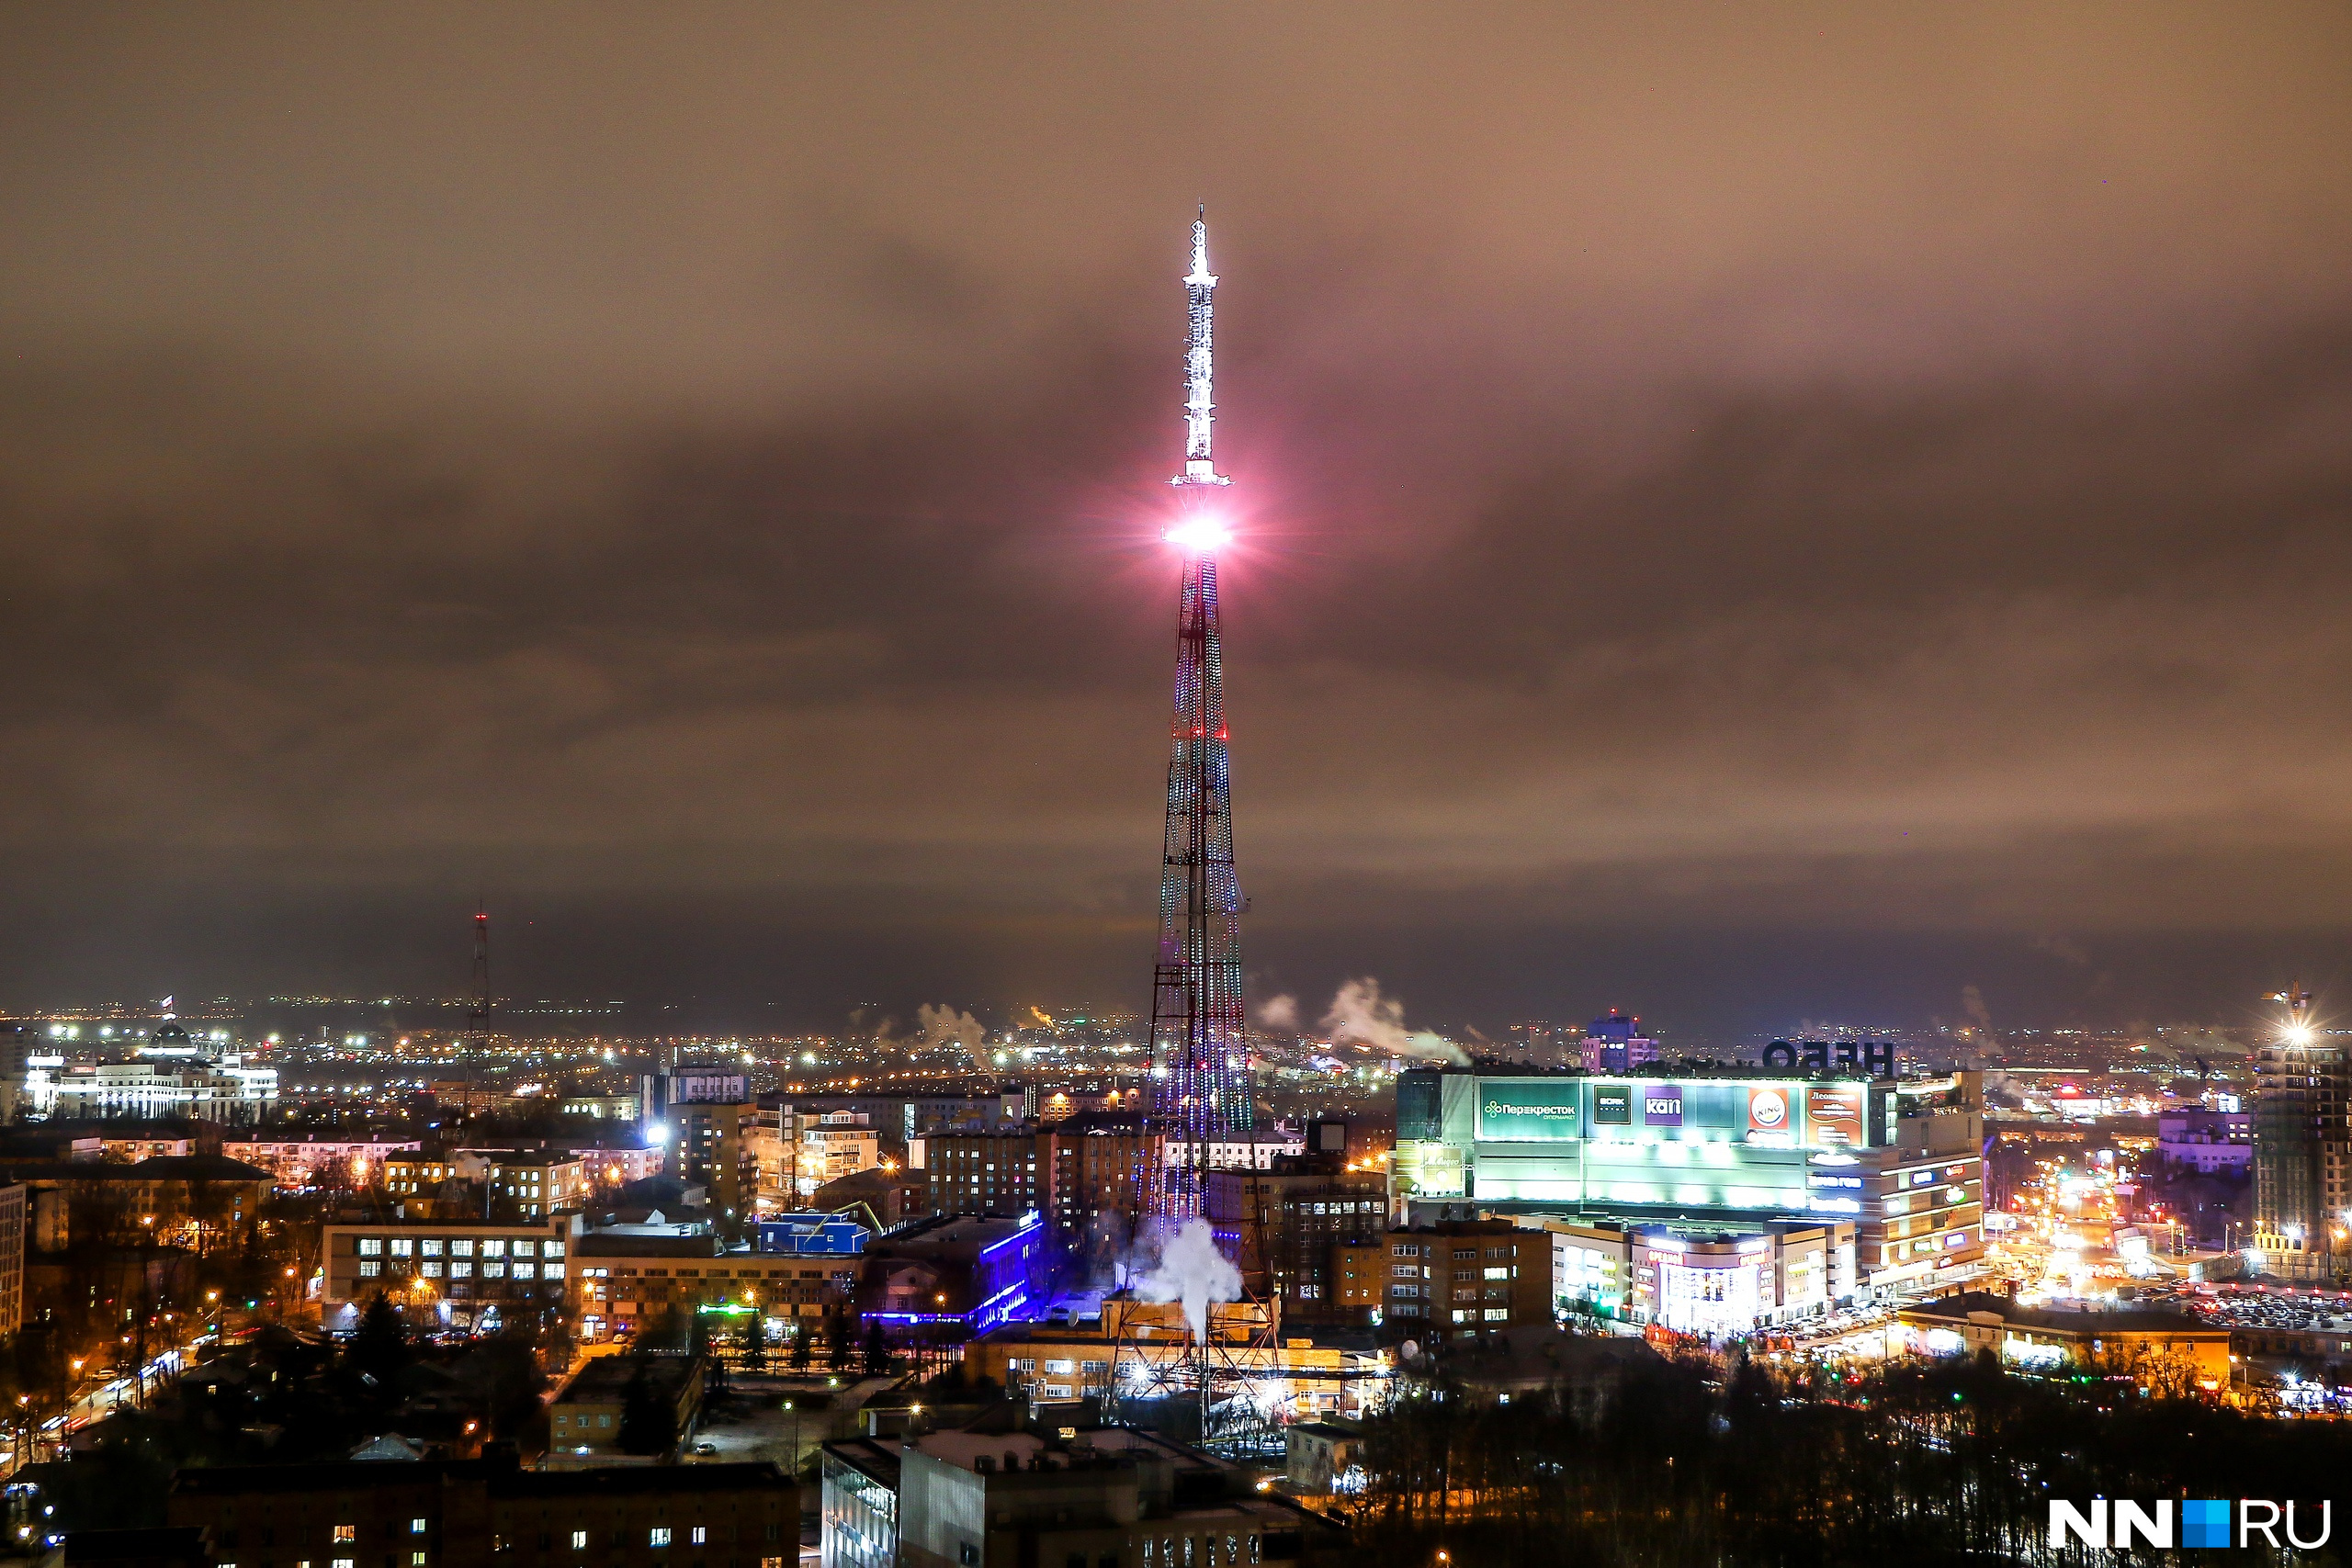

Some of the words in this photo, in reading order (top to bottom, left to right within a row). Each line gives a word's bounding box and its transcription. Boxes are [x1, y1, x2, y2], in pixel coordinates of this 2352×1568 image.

[1502, 1104, 1576, 1117] Перекресток
[1646, 1099, 1680, 1114] kari
[1758, 1104, 1781, 1117] KING
